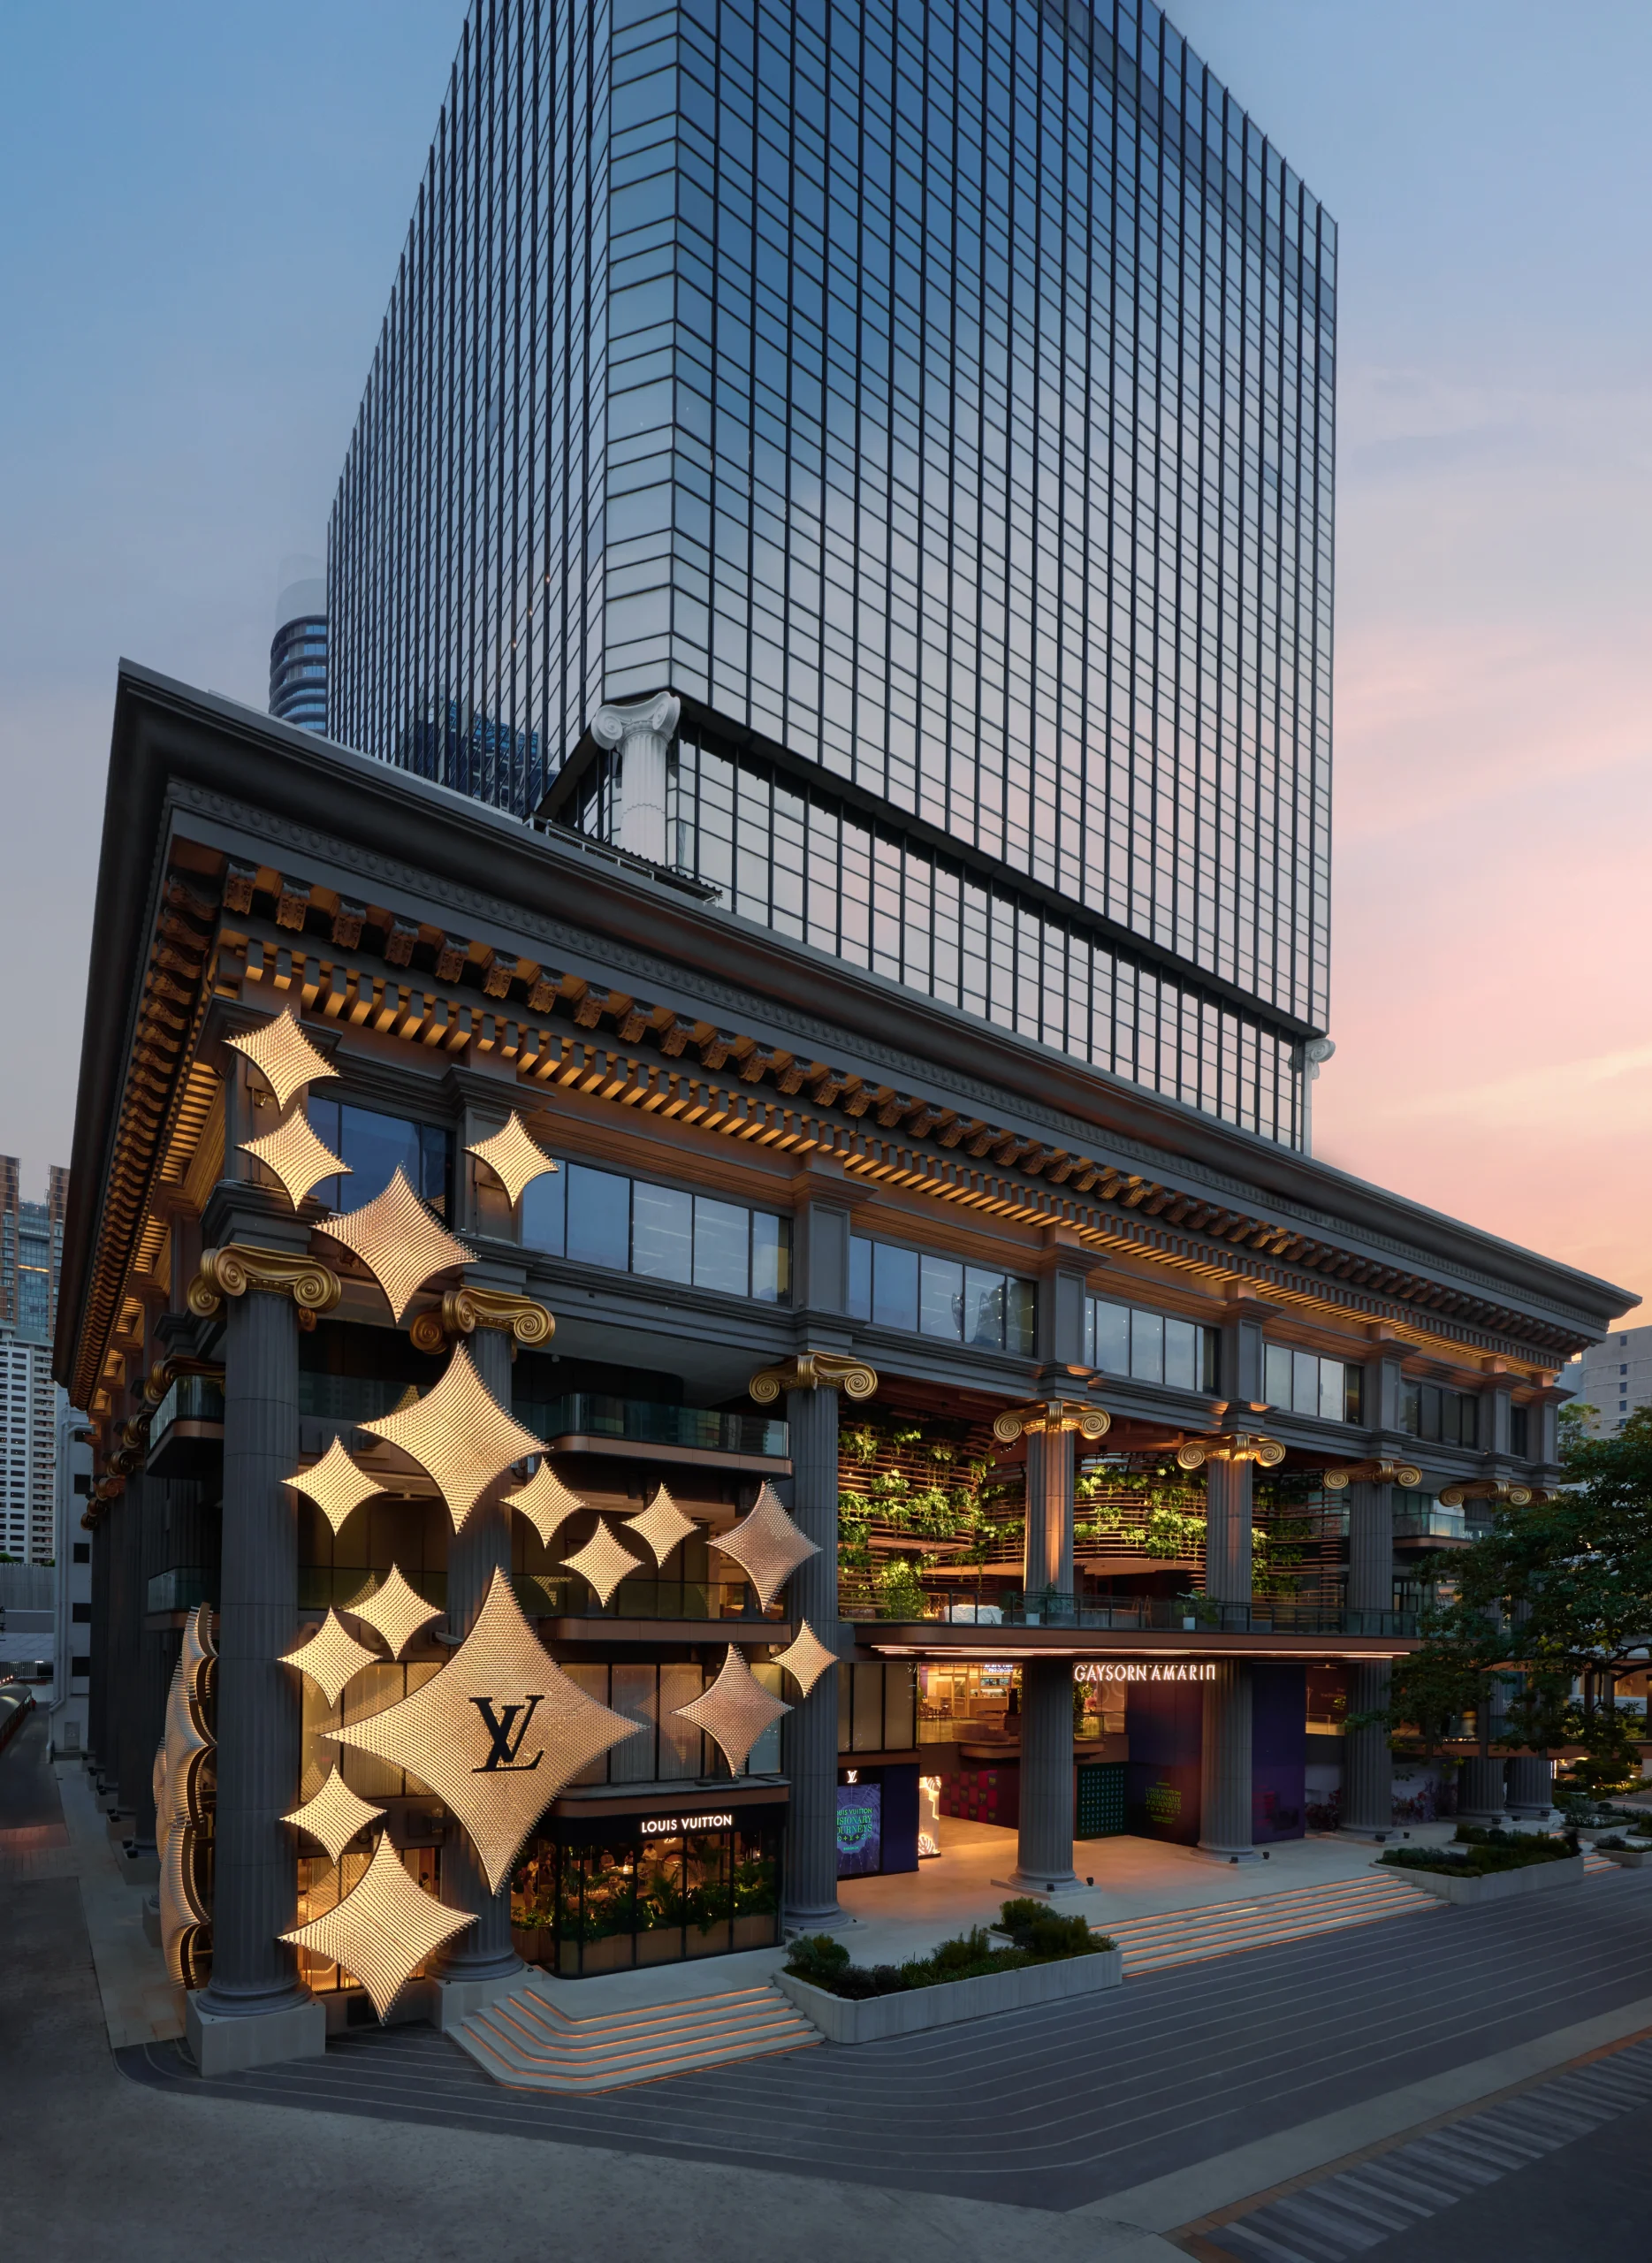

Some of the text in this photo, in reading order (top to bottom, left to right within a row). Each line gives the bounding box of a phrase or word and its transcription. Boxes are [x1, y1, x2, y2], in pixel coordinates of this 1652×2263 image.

[1074, 1665, 1146, 1681] GAYSORN
[468, 1695, 544, 1773] LV
[642, 1814, 732, 1833] LOUIS VUITTON
[836, 1815, 872, 1826] ISIONARY
[837, 1825, 872, 1834] OURNEYS
